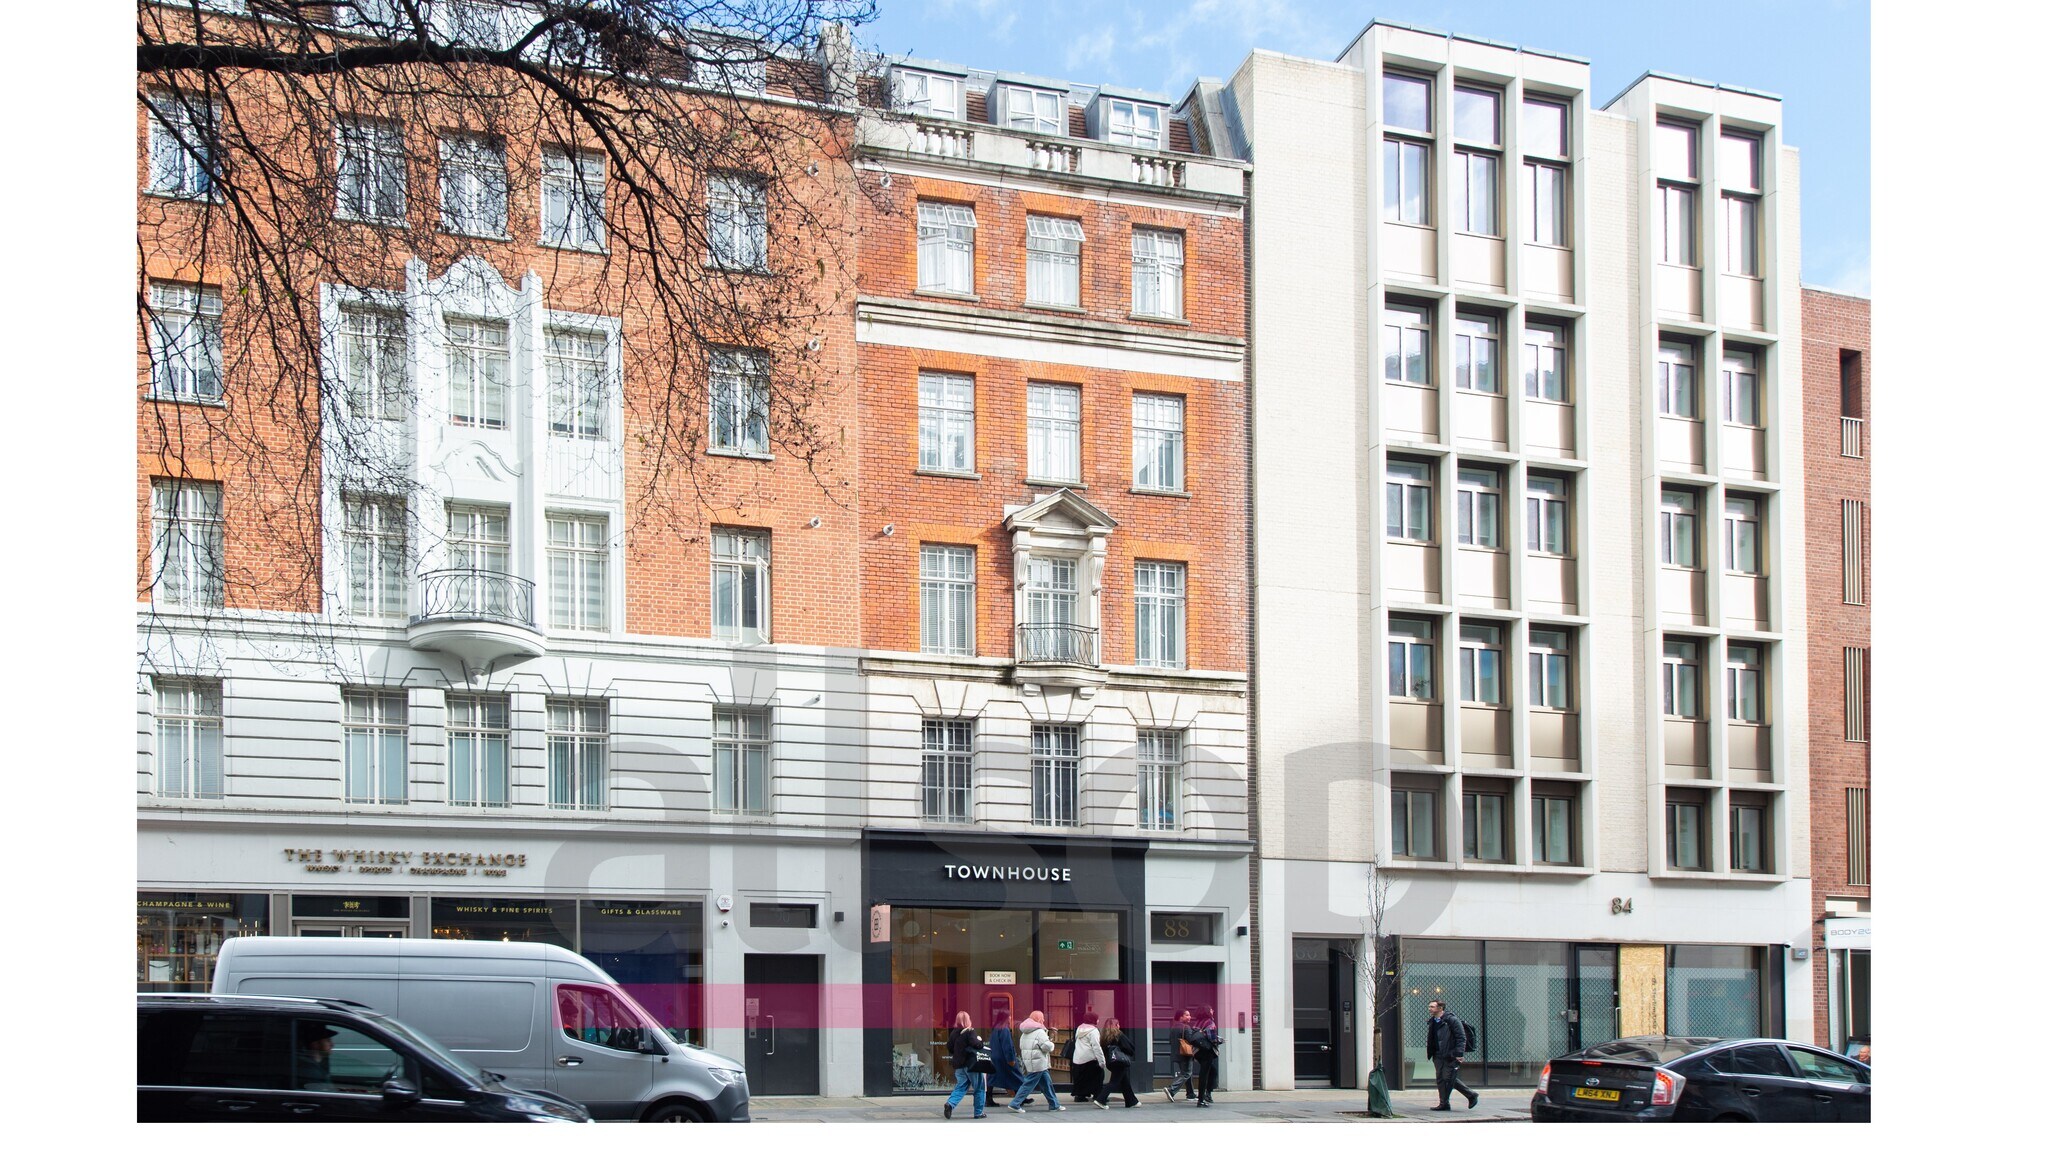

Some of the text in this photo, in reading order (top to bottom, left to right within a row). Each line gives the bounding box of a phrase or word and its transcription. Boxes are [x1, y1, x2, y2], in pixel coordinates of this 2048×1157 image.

[284, 849, 526, 867] THE WHISKY EXCHANGE
[305, 865, 507, 877] WHISKY SPIRITS CHAMPAGNE WINE
[944, 865, 1072, 881] TOWNHOUSE
[1611, 897, 1634, 915] 84
[1164, 919, 1190, 938] 88
